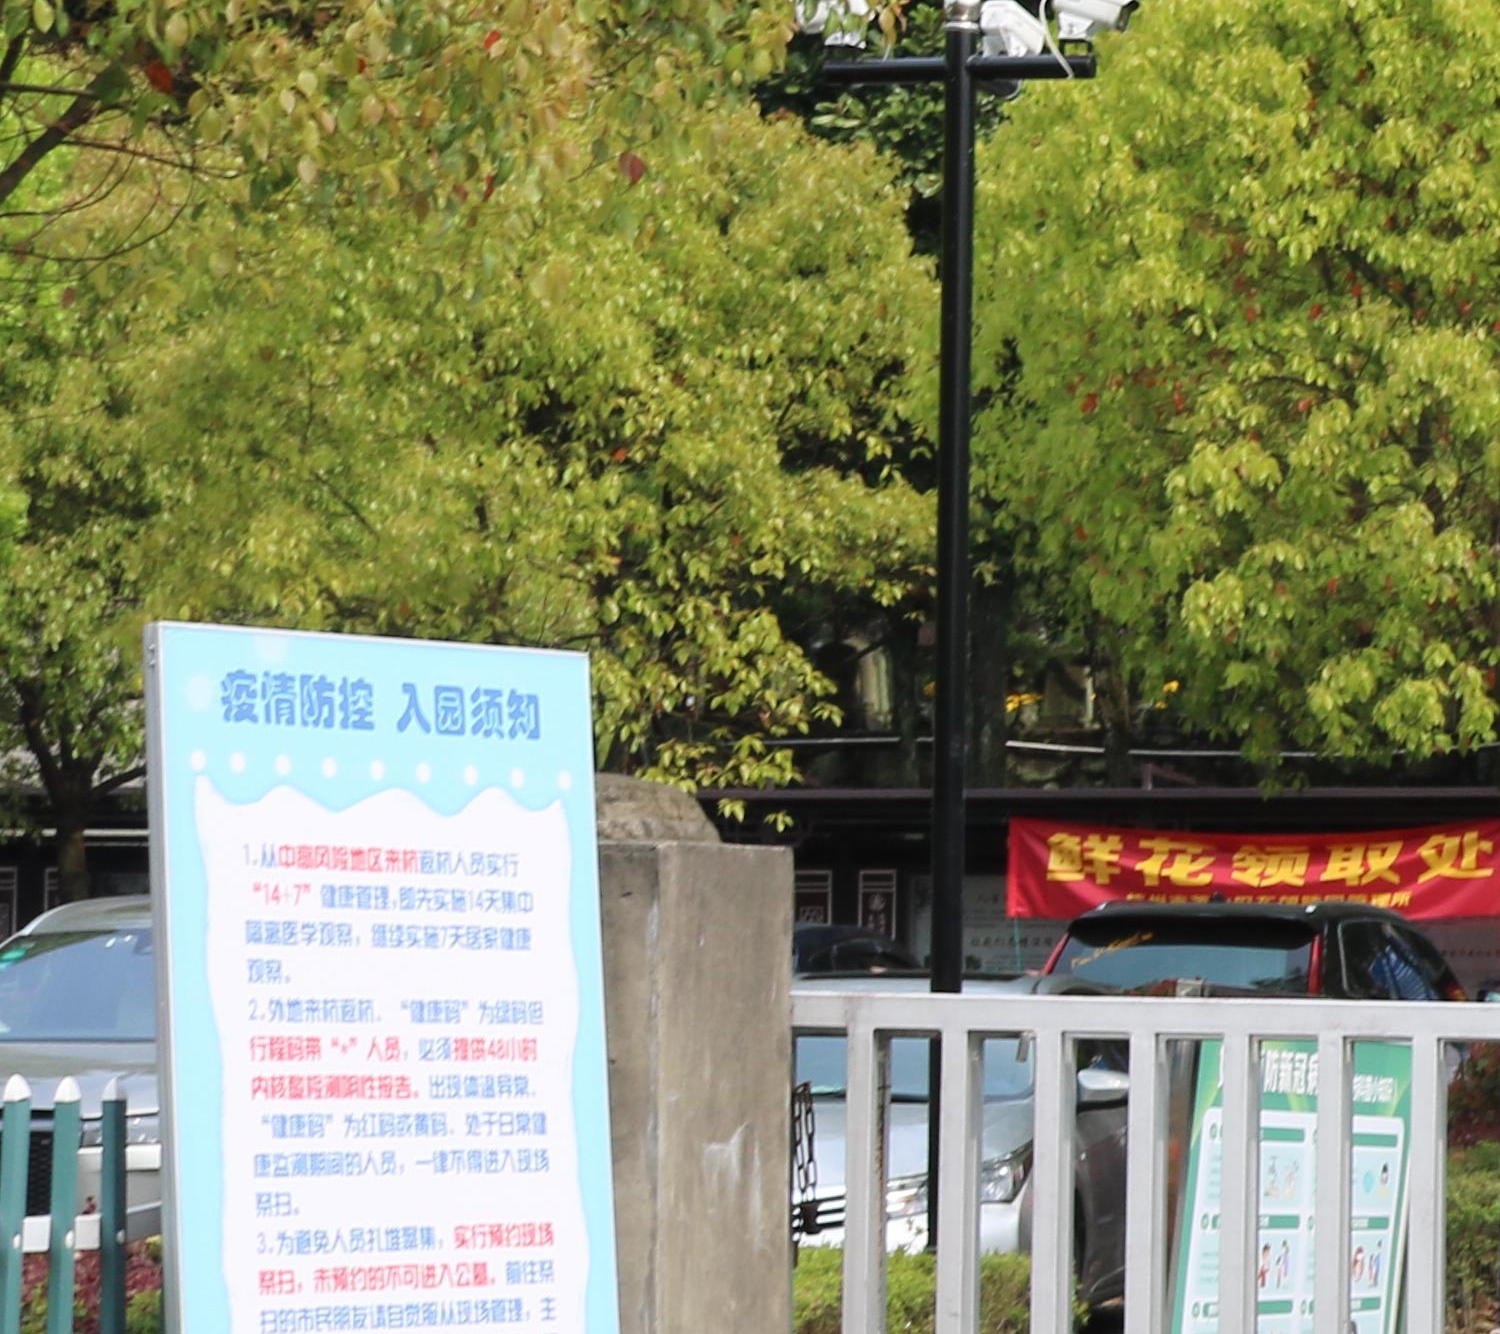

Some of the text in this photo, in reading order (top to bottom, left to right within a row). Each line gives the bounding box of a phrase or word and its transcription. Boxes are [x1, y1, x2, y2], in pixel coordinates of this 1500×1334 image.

[220, 669, 541, 741] 疫情防控 入园须知
[1046, 830, 1495, 887] 鲜花领取处
